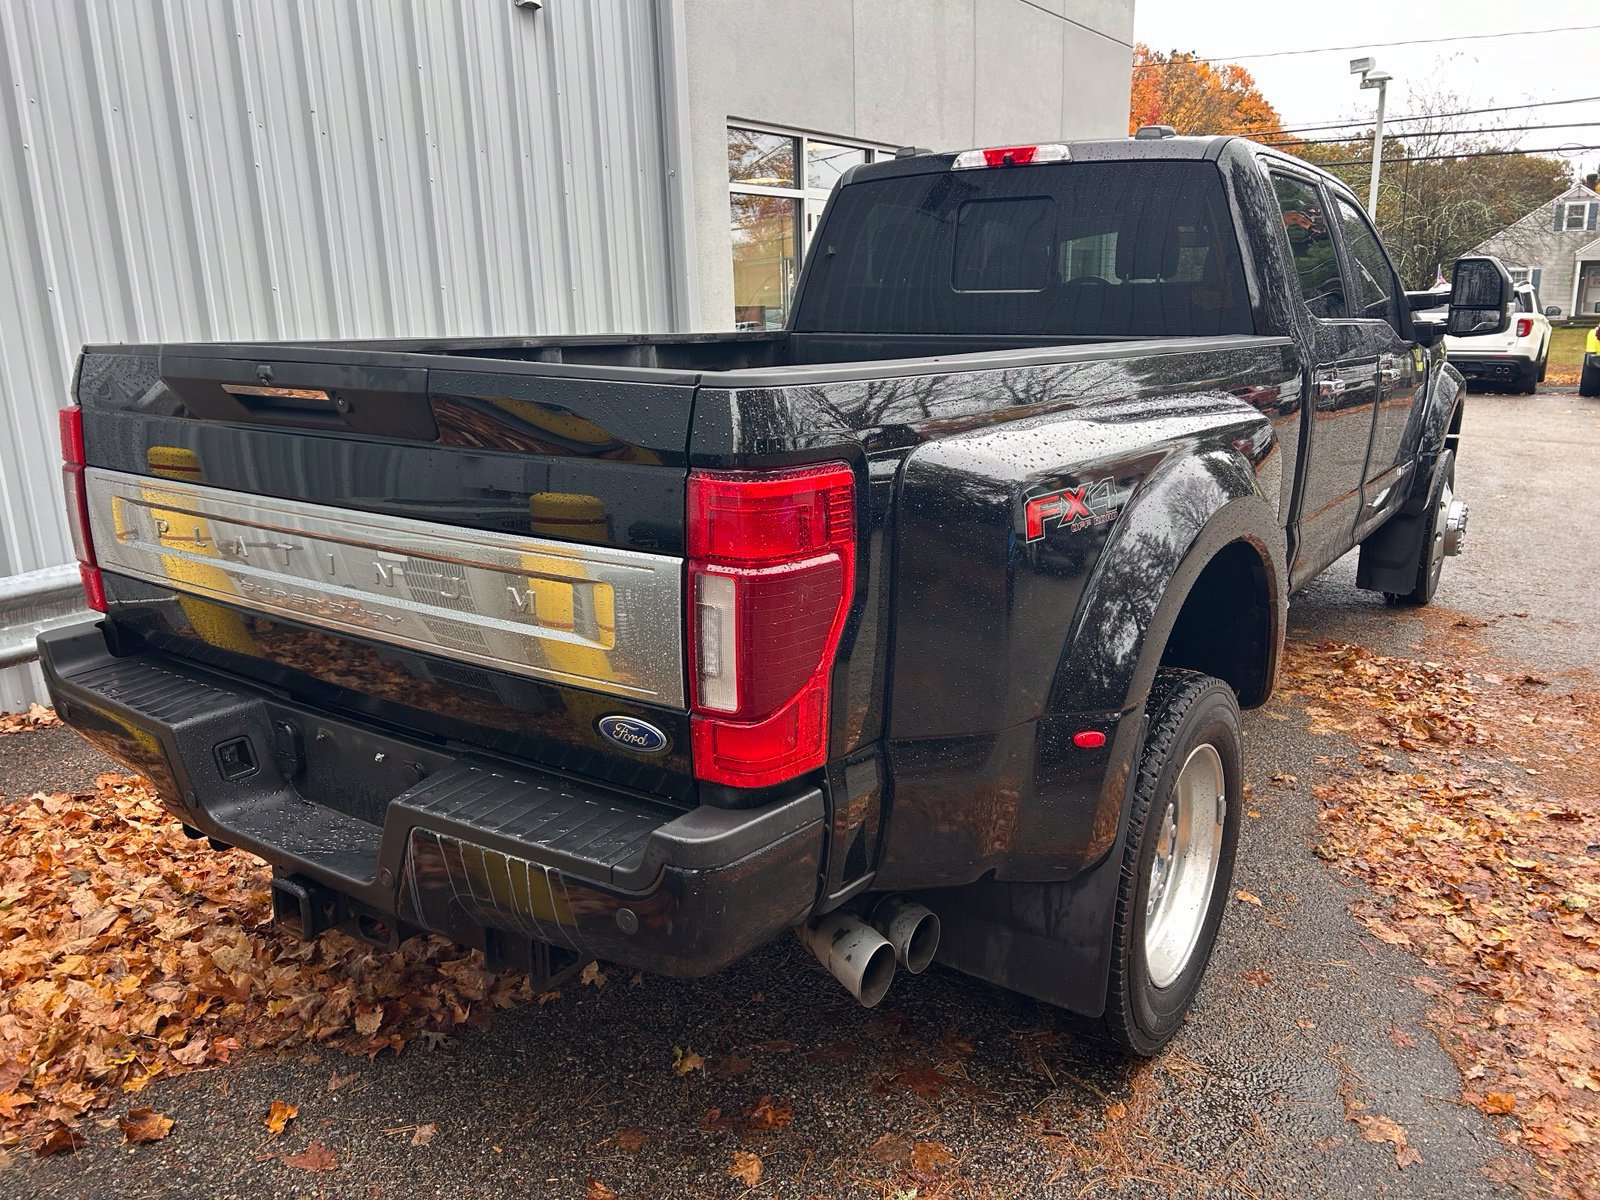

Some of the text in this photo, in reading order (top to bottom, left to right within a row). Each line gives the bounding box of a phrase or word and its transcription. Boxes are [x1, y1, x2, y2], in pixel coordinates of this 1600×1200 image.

[1024, 476, 1118, 544] FX4
[155, 517, 537, 615] PLATINUM
[242, 580, 322, 609] SUPER
[612, 722, 650, 746] Ford
